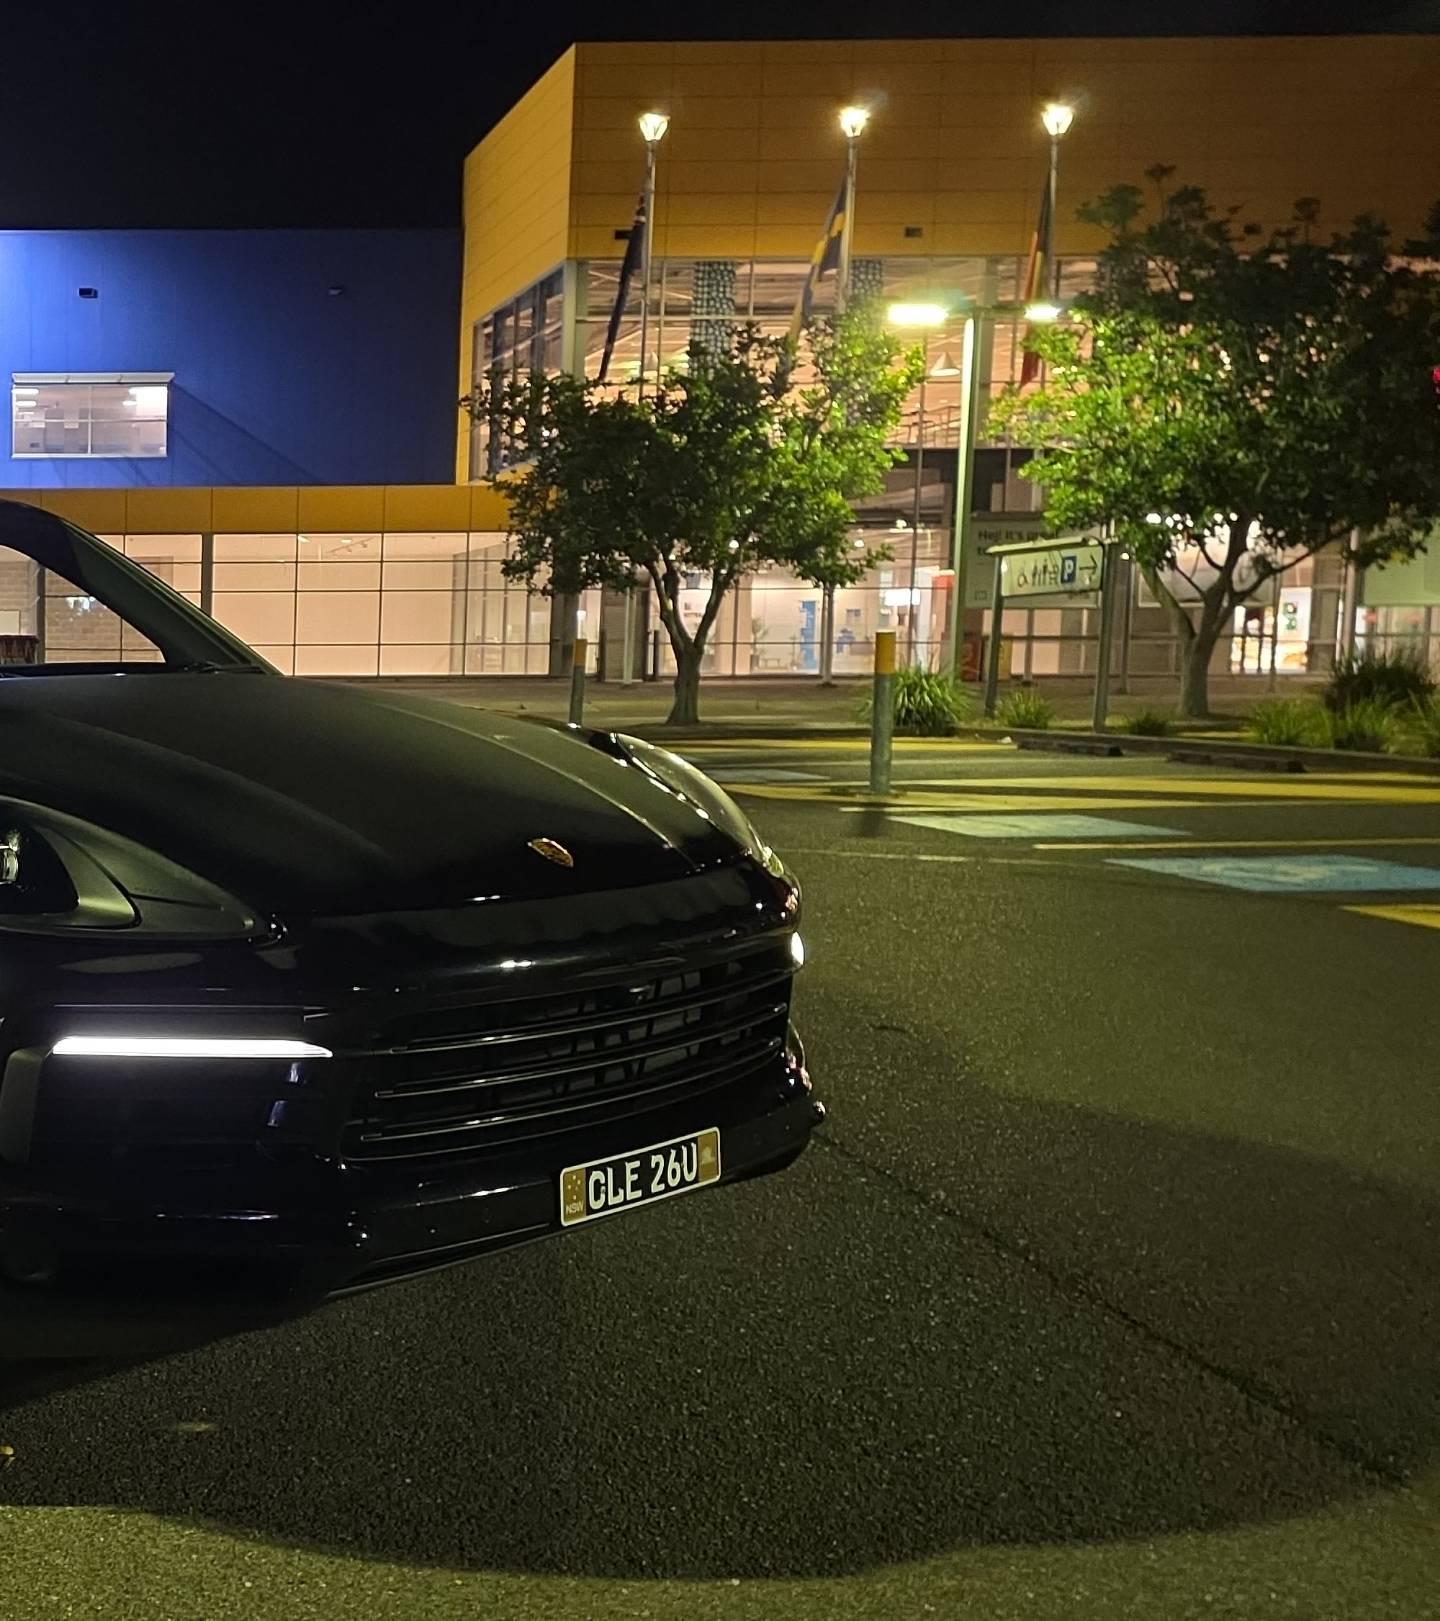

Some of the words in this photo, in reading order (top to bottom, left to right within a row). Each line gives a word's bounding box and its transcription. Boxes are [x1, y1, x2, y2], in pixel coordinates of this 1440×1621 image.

[588, 1160, 642, 1210] CLE
[651, 1142, 698, 1193] 26U
[565, 1200, 585, 1215] NSW
